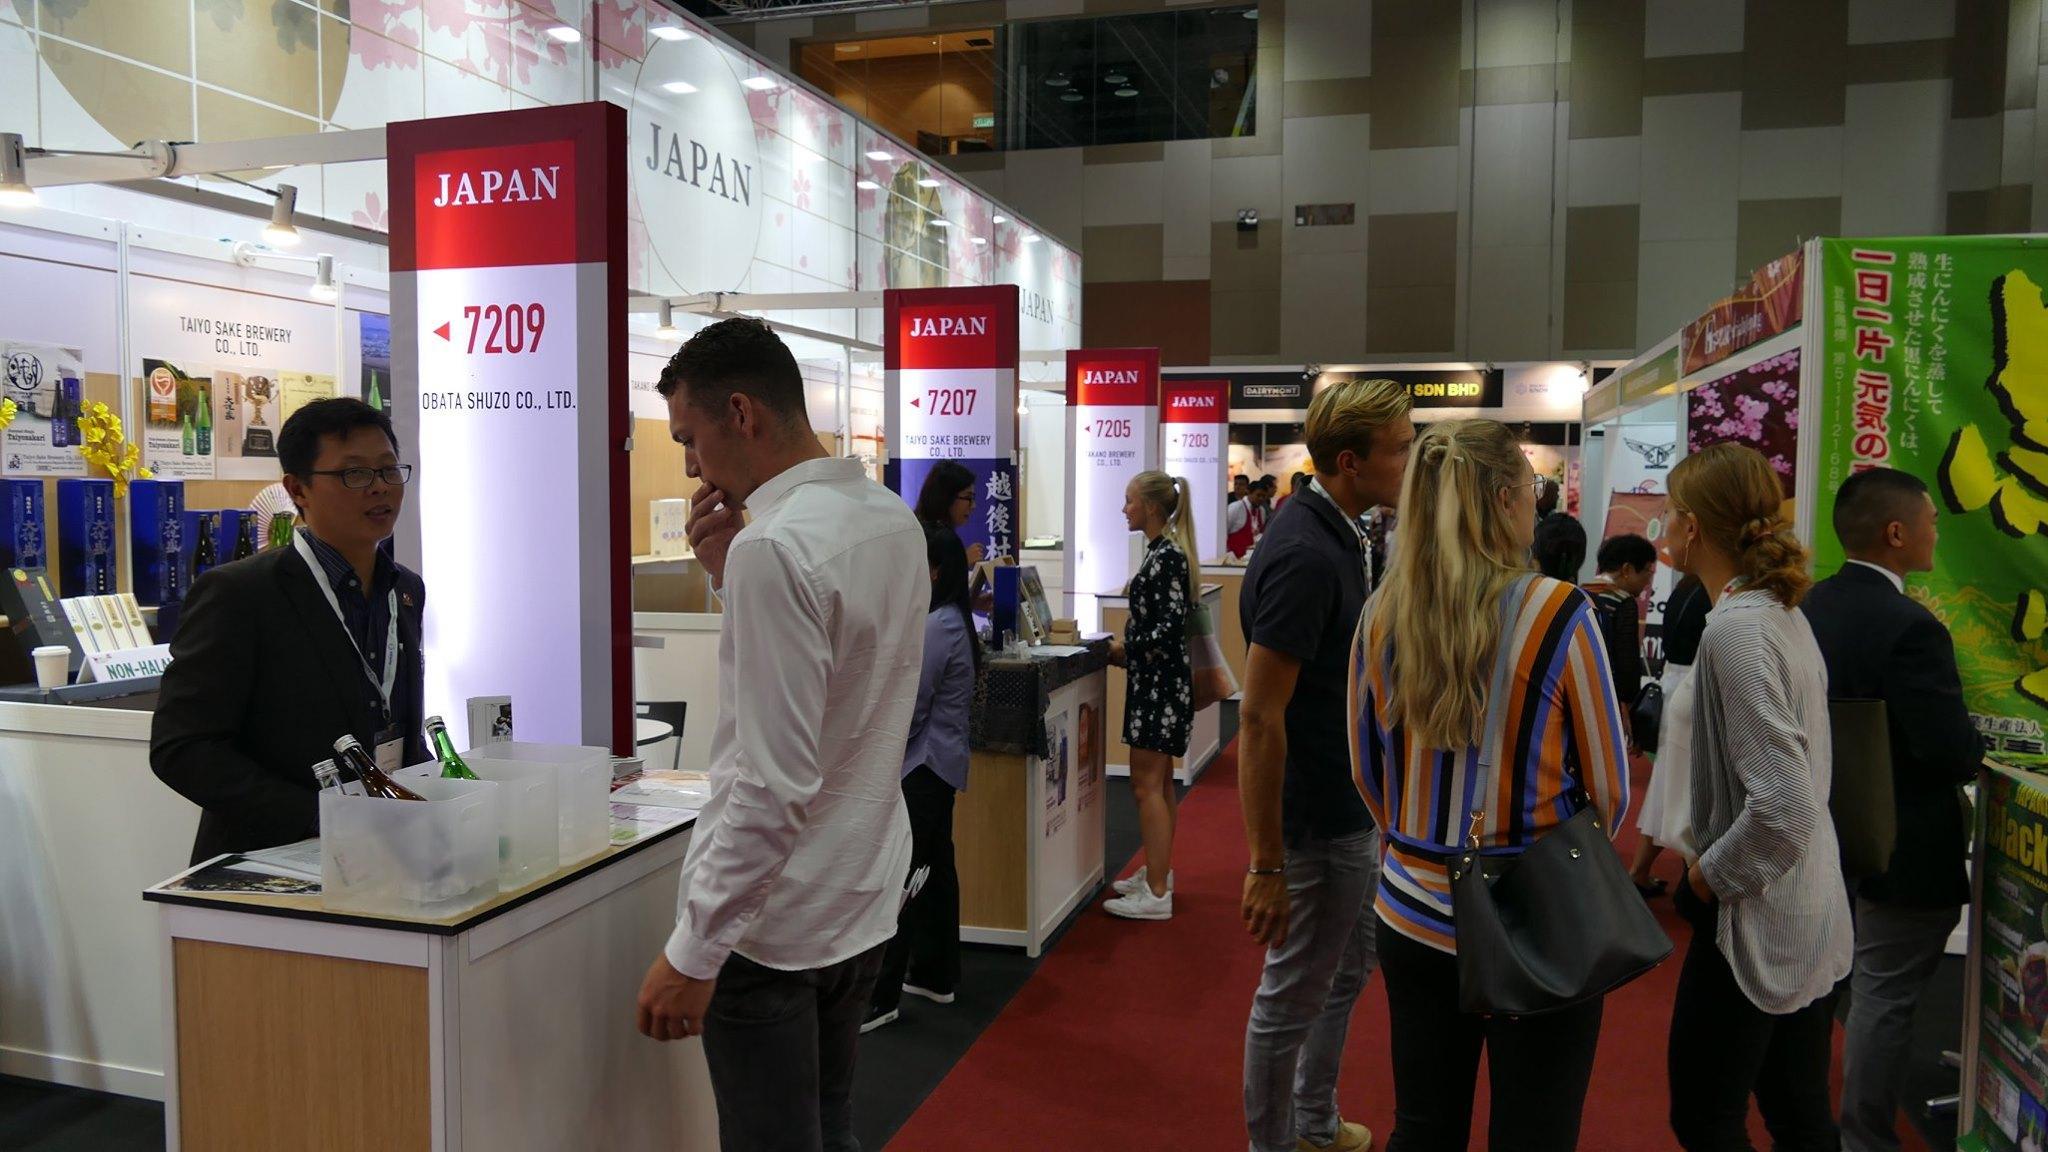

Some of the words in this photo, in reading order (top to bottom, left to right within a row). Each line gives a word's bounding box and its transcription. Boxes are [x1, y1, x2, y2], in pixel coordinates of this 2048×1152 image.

[646, 122, 751, 207] JAPAN
[433, 166, 560, 208] JAPAN
[1021, 288, 1054, 325] JAPAN
[1852, 248, 1896, 362] 一日一片
[180, 316, 211, 334] TAIYO
[215, 320, 242, 338] SAKE
[245, 325, 292, 343] BREWERY
[464, 302, 546, 354] 7209
[910, 316, 988, 337] JAPAN
[1927, 253, 1953, 414] 生にんにくを蒸して
[215, 338, 236, 355] CO.,
[240, 341, 262, 356] LTD.
[1083, 370, 1139, 385] JAPAN
[422, 392, 463, 410] OBATA
[467, 391, 510, 410] SHUZO
[516, 390, 542, 411] CO.,
[547, 389, 577, 409] LTD.
[1414, 383, 1445, 397] SDN
[1447, 383, 1480, 397] BHD
[928, 389, 977, 416] 7207
[1172, 396, 1215, 408] JAPAN
[1096, 419, 1131, 438] 7205
[906, 435, 928, 445] TAIYO
[930, 435, 951, 446] SAKE
[953, 435, 991, 446] BREWERY
[1182, 434, 1210, 448] 7203
[929, 447, 945, 458] CO.,
[948, 447, 965, 457] LTD.
[1087, 450, 1107, 458] AKANO
[1108, 450, 1136, 459] BREWERY
[105, 657, 170, 680] NON-HALA
